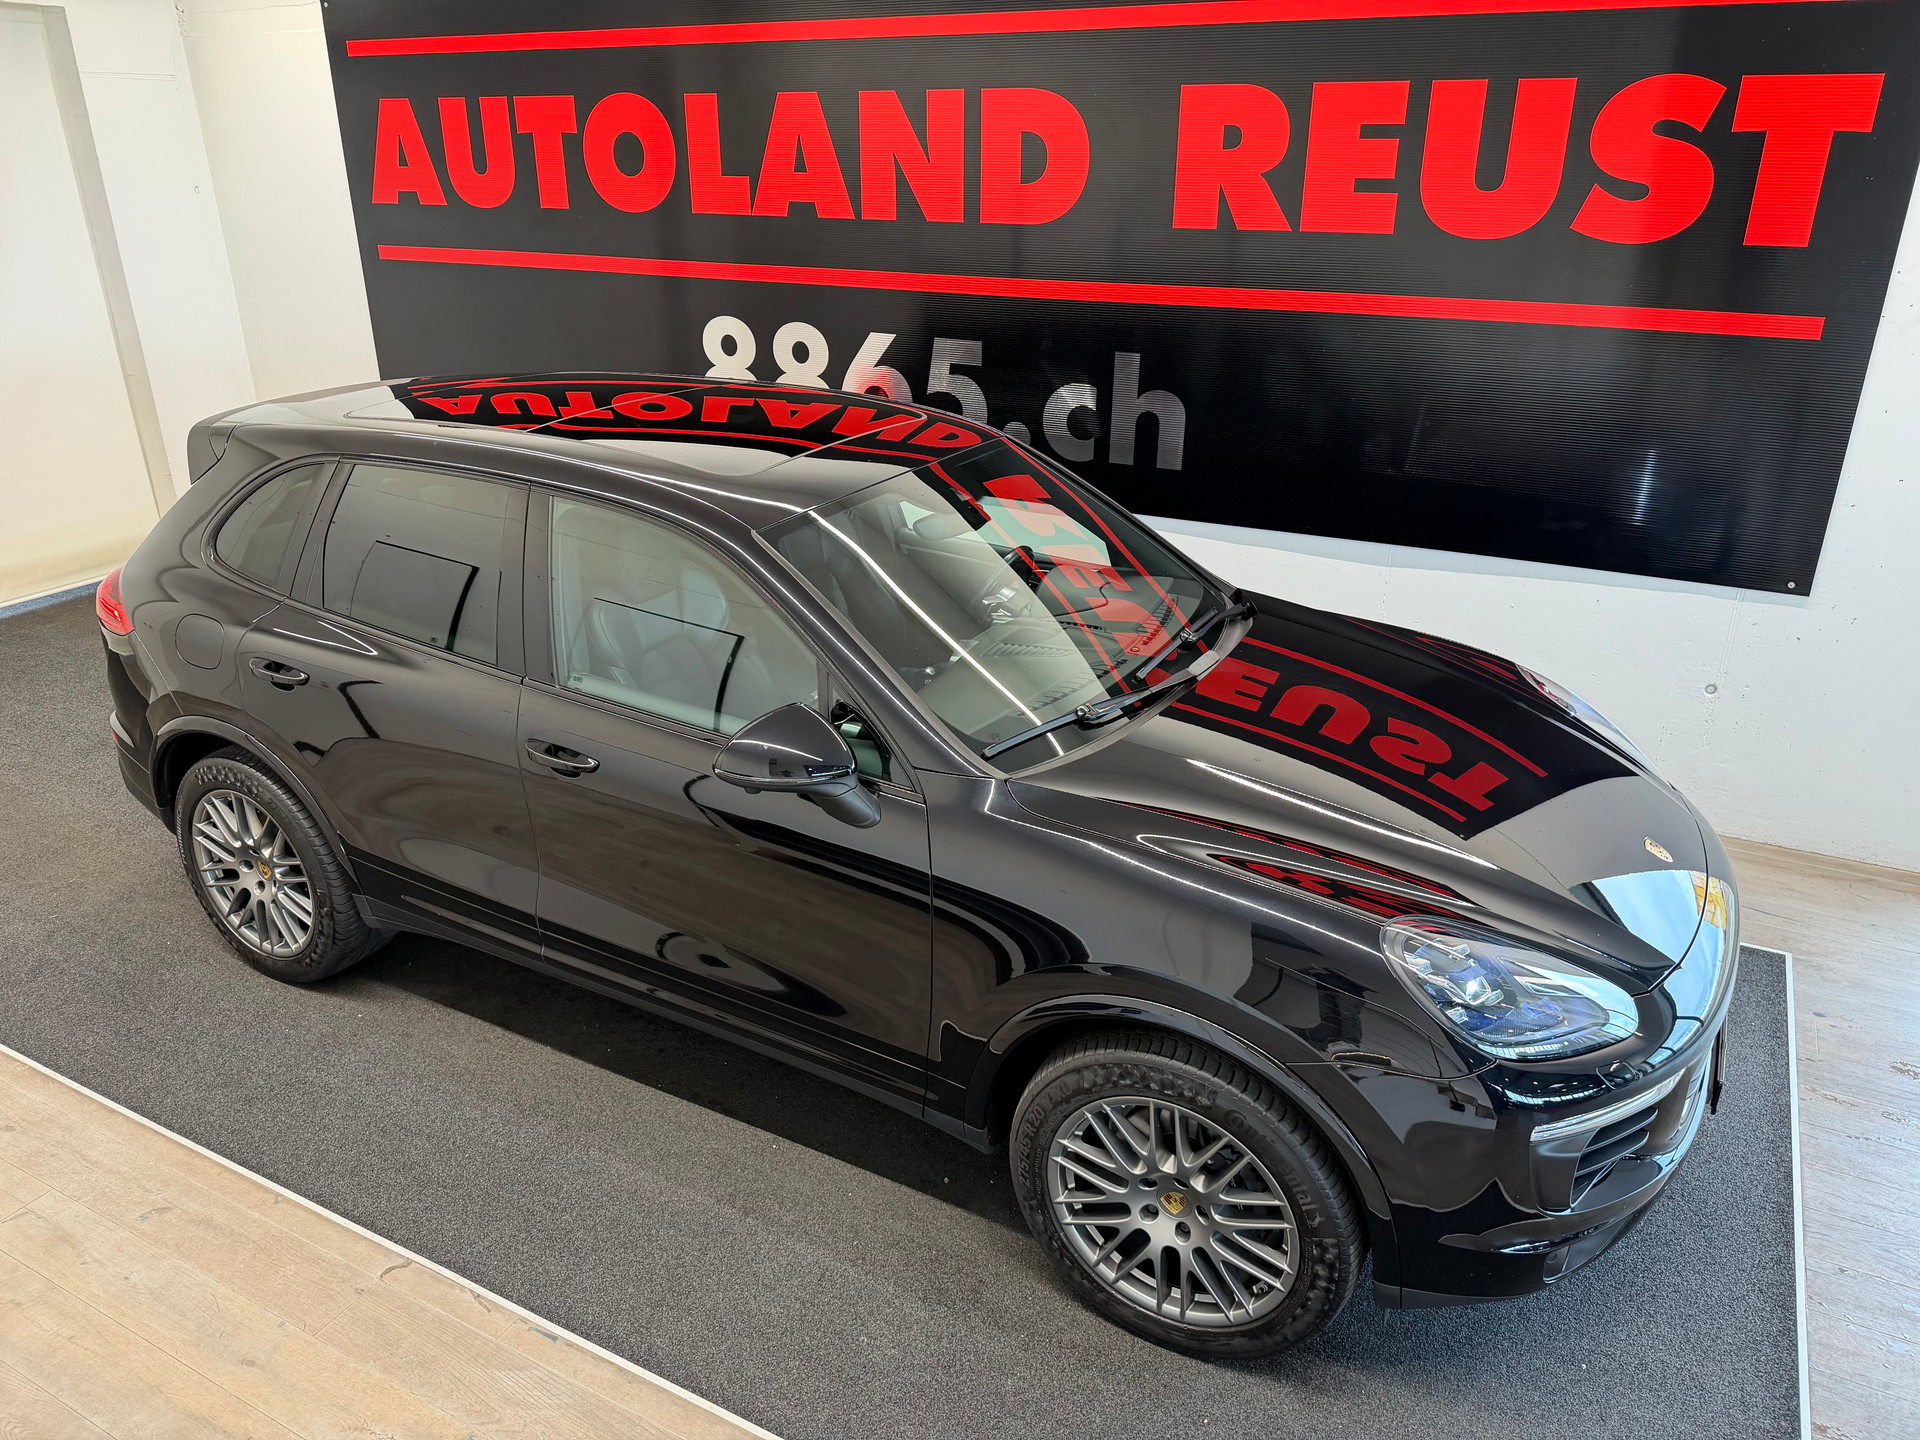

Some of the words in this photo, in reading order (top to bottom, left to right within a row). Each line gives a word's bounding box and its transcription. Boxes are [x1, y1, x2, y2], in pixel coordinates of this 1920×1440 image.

[372, 88, 1091, 225] AUTOLAND
[1172, 73, 1886, 248] REUST
[702, 315, 1186, 470] 8865.ch
[1018, 1137, 1032, 1188] 275/45
[1222, 1109, 1321, 1212] Contiental
